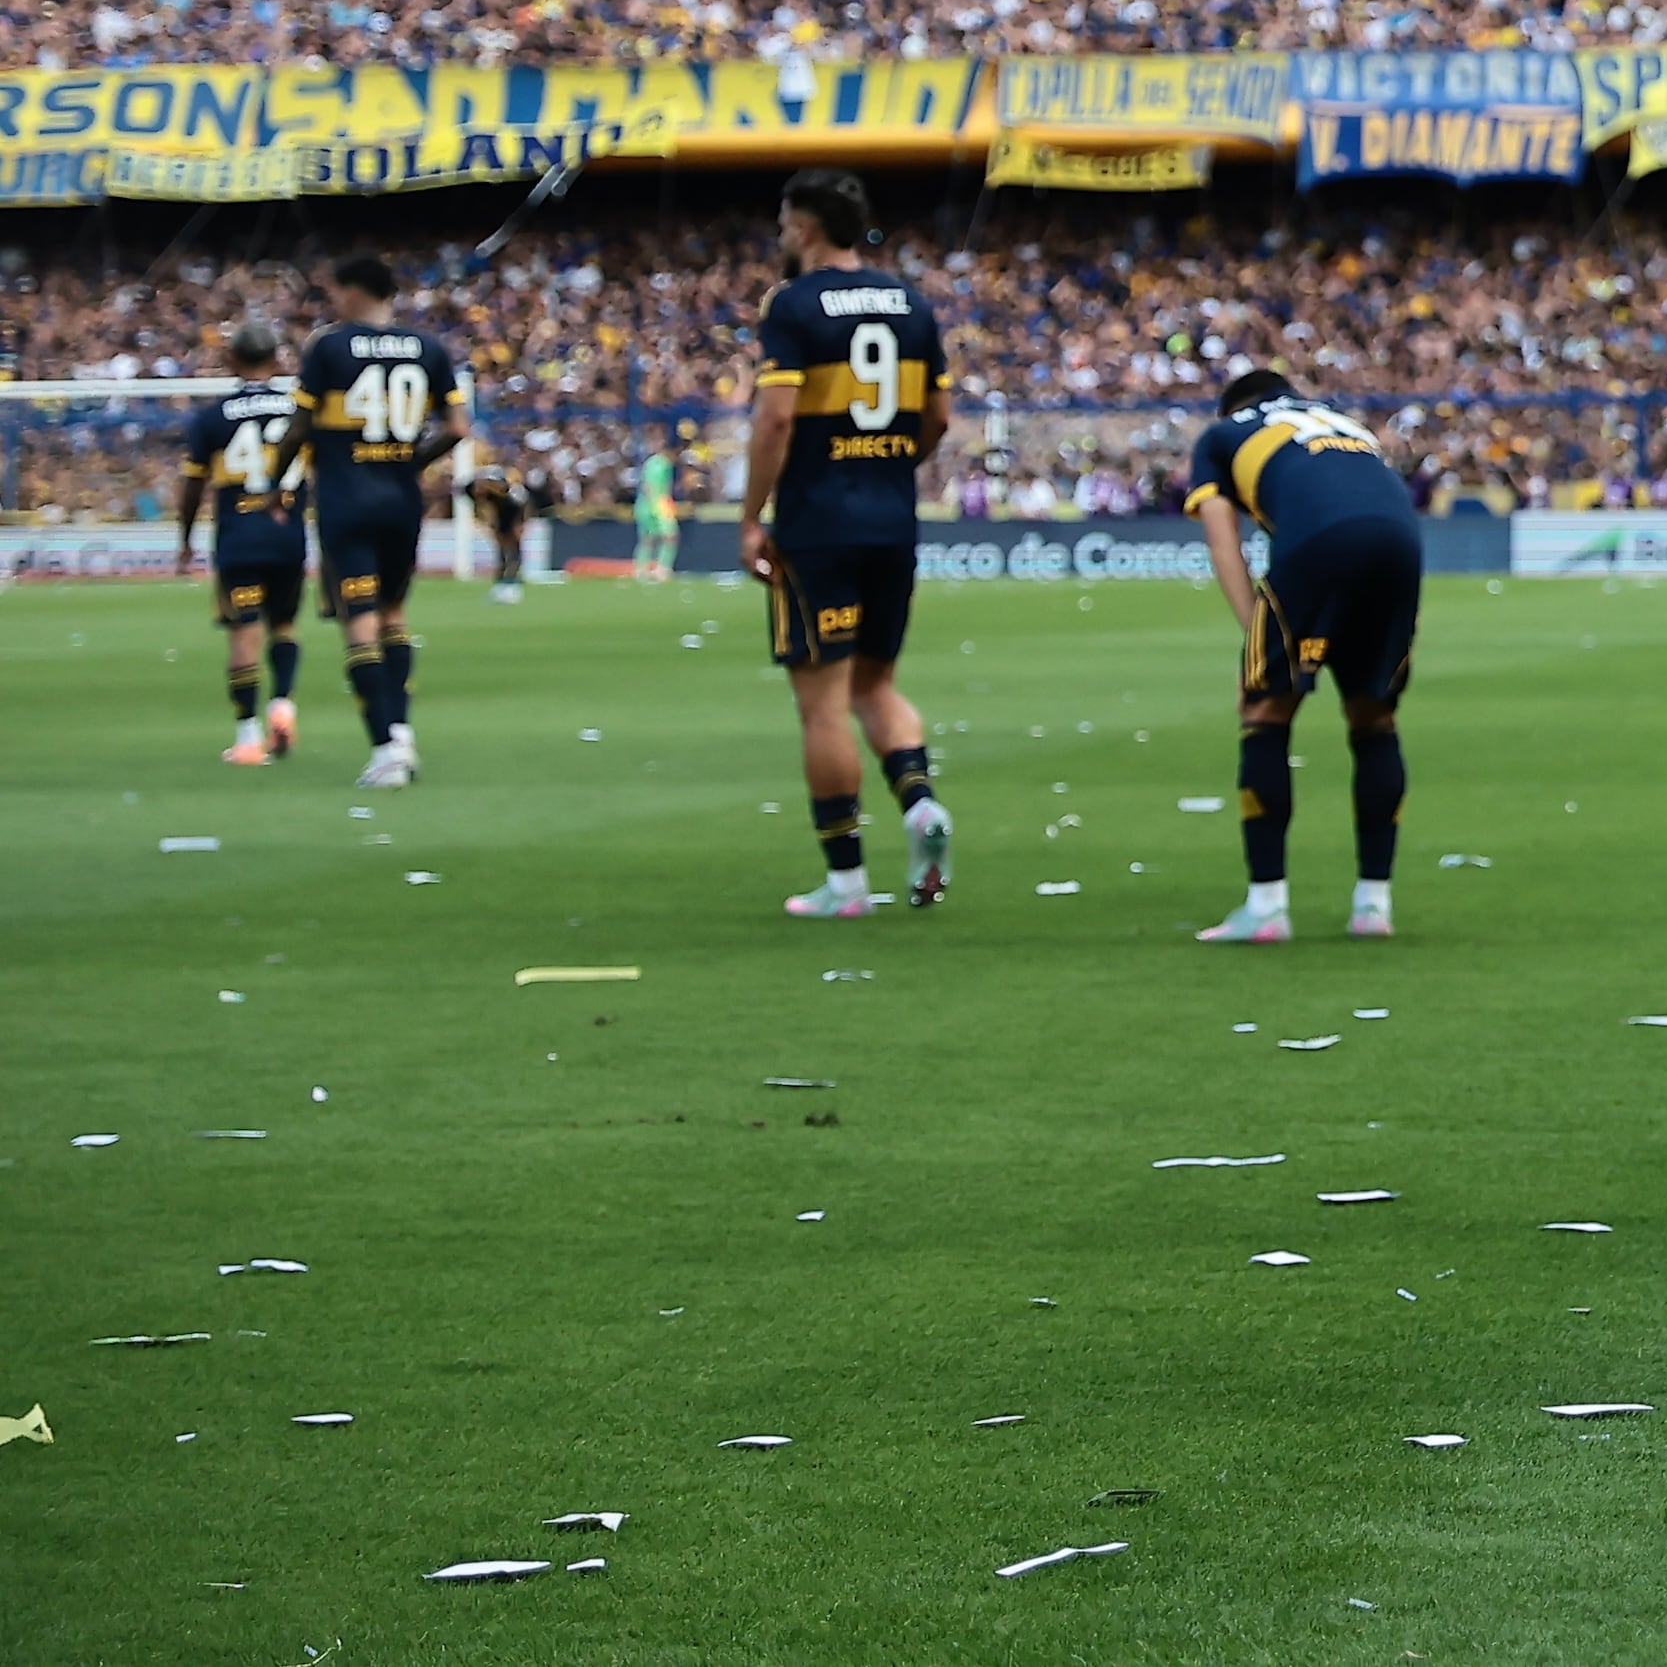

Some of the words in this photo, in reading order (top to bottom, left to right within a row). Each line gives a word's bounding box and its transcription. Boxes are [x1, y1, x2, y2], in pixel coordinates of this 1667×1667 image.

[1301, 51, 1580, 103] VICTORIA
[1360, 109, 1581, 176] DIAMANTE
[343, 362, 430, 444] 40
[849, 321, 899, 431] 9
[914, 542, 1004, 581] nco
[1008, 531, 1072, 581] de
